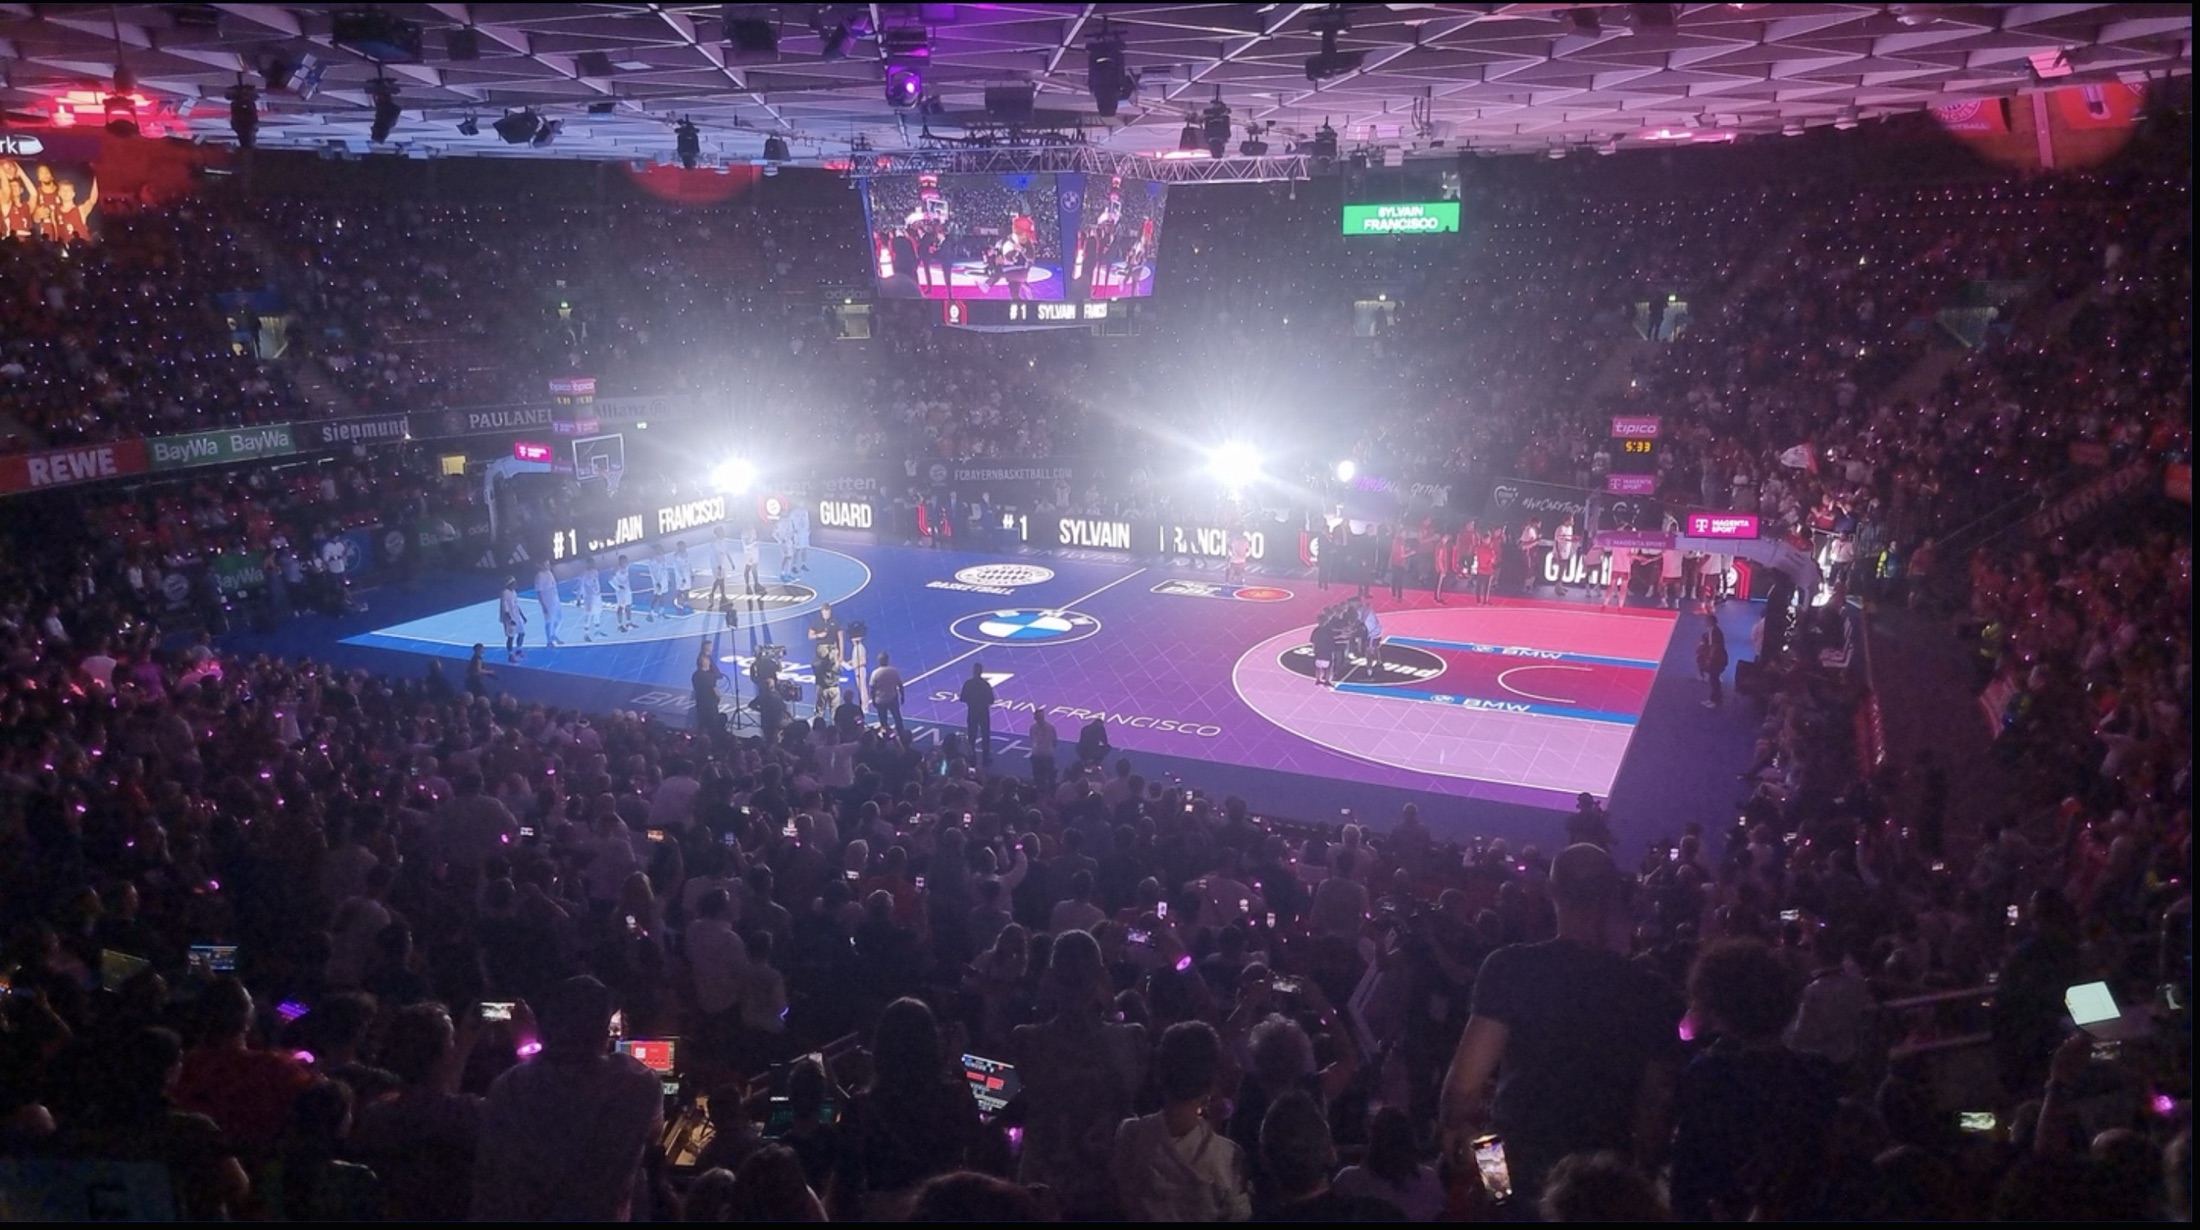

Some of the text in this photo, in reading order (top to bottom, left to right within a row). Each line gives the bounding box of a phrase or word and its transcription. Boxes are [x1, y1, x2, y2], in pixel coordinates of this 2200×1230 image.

[1378, 206, 1424, 218] SYLVAIN
[1364, 217, 1438, 231] FRANCISCO
[1037, 303, 1077, 320] SYLVAIN
[1616, 422, 1657, 435] tipico
[154, 431, 289, 463] BayWa BayWa
[28, 448, 118, 486] REWE
[825, 477, 876, 491] etten
[659, 497, 725, 534] FRANCISCO
[819, 501, 872, 528] GUARD
[1711, 519, 1750, 528] MAGENTA
[1711, 526, 1737, 534] SPORT
[1059, 518, 1131, 549] SYLVAIN
[1502, 647, 1562, 660] BMW
[1463, 698, 1531, 713] BMW
[1048, 705, 1223, 738] FRANCISCO
